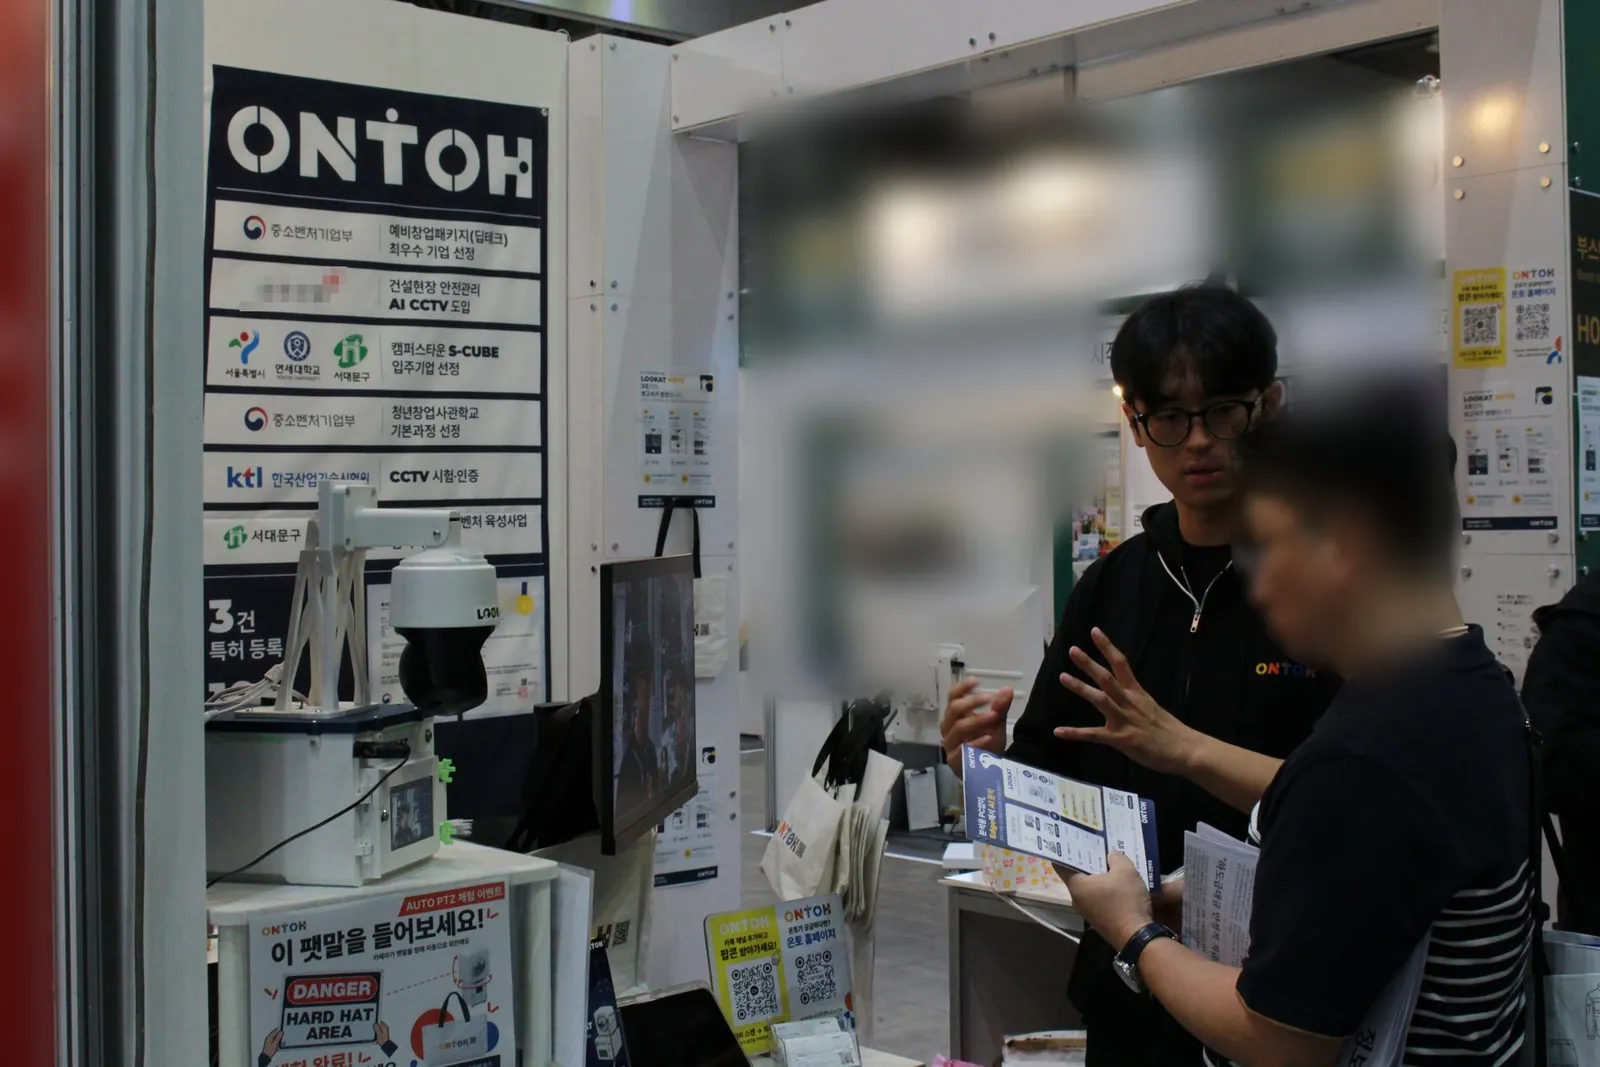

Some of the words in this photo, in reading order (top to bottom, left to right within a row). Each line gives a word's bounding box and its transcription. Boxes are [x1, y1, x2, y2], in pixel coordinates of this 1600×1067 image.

[227, 105, 532, 199] ONTOH
[270, 223, 353, 243] 중소벤처기업부
[389, 223, 508, 248] 예비창업패키지(딥테크)
[389, 243, 424, 258] 최우수
[426, 245, 451, 261] 기업
[453, 246, 475, 262] 선정
[1512, 268, 1555, 281] ONTOH
[389, 278, 436, 295] 건설현장
[439, 281, 481, 298] 안전관리
[389, 298, 405, 311] AI
[409, 298, 449, 312] CCTV
[450, 299, 471, 314] 도입
[391, 341, 446, 358] 캠퍼스타운
[448, 345, 499, 359] S-CUBE
[225, 366, 266, 380] 서울특별시
[275, 363, 321, 376] 연세대학교
[333, 370, 371, 383] 서대문구
[392, 360, 435, 376] 입주기업
[438, 361, 460, 377] 선정
[1463, 394, 1493, 403] LOOKAT
[272, 413, 356, 428] 중소벤처기업부
[392, 405, 479, 420] 청년창업사관학교
[391, 424, 436, 439] 기본과정
[439, 424, 461, 438] 선정
[227, 464, 263, 488] ktl
[389, 470, 429, 483] CCTV
[485, 513, 528, 528] 육성사업
[251, 528, 301, 543] 서대문구
[209, 640, 245, 662] 특허
[248, 637, 284, 660] 등록
[406, 897, 435, 912] AUTO
[436, 895, 457, 908] PTZ
[457, 890, 475, 904] 체험
[477, 885, 503, 901] 이벤트
[784, 903, 832, 922] ONTOH
[261, 920, 307, 937] ONTOH
[271, 939, 293, 966] 이
[300, 927, 367, 963] 팻말을
[372, 908, 484, 949] 들어보세요!
[590, 941, 604, 951] TOH
[786, 937, 803, 950] 온토
[804, 929, 837, 946] 홈페이지
[293, 979, 372, 1000] DANGER
[286, 1009, 335, 1027] HARD
[340, 1008, 374, 1023] HAT
[306, 1024, 352, 1042] AREA
